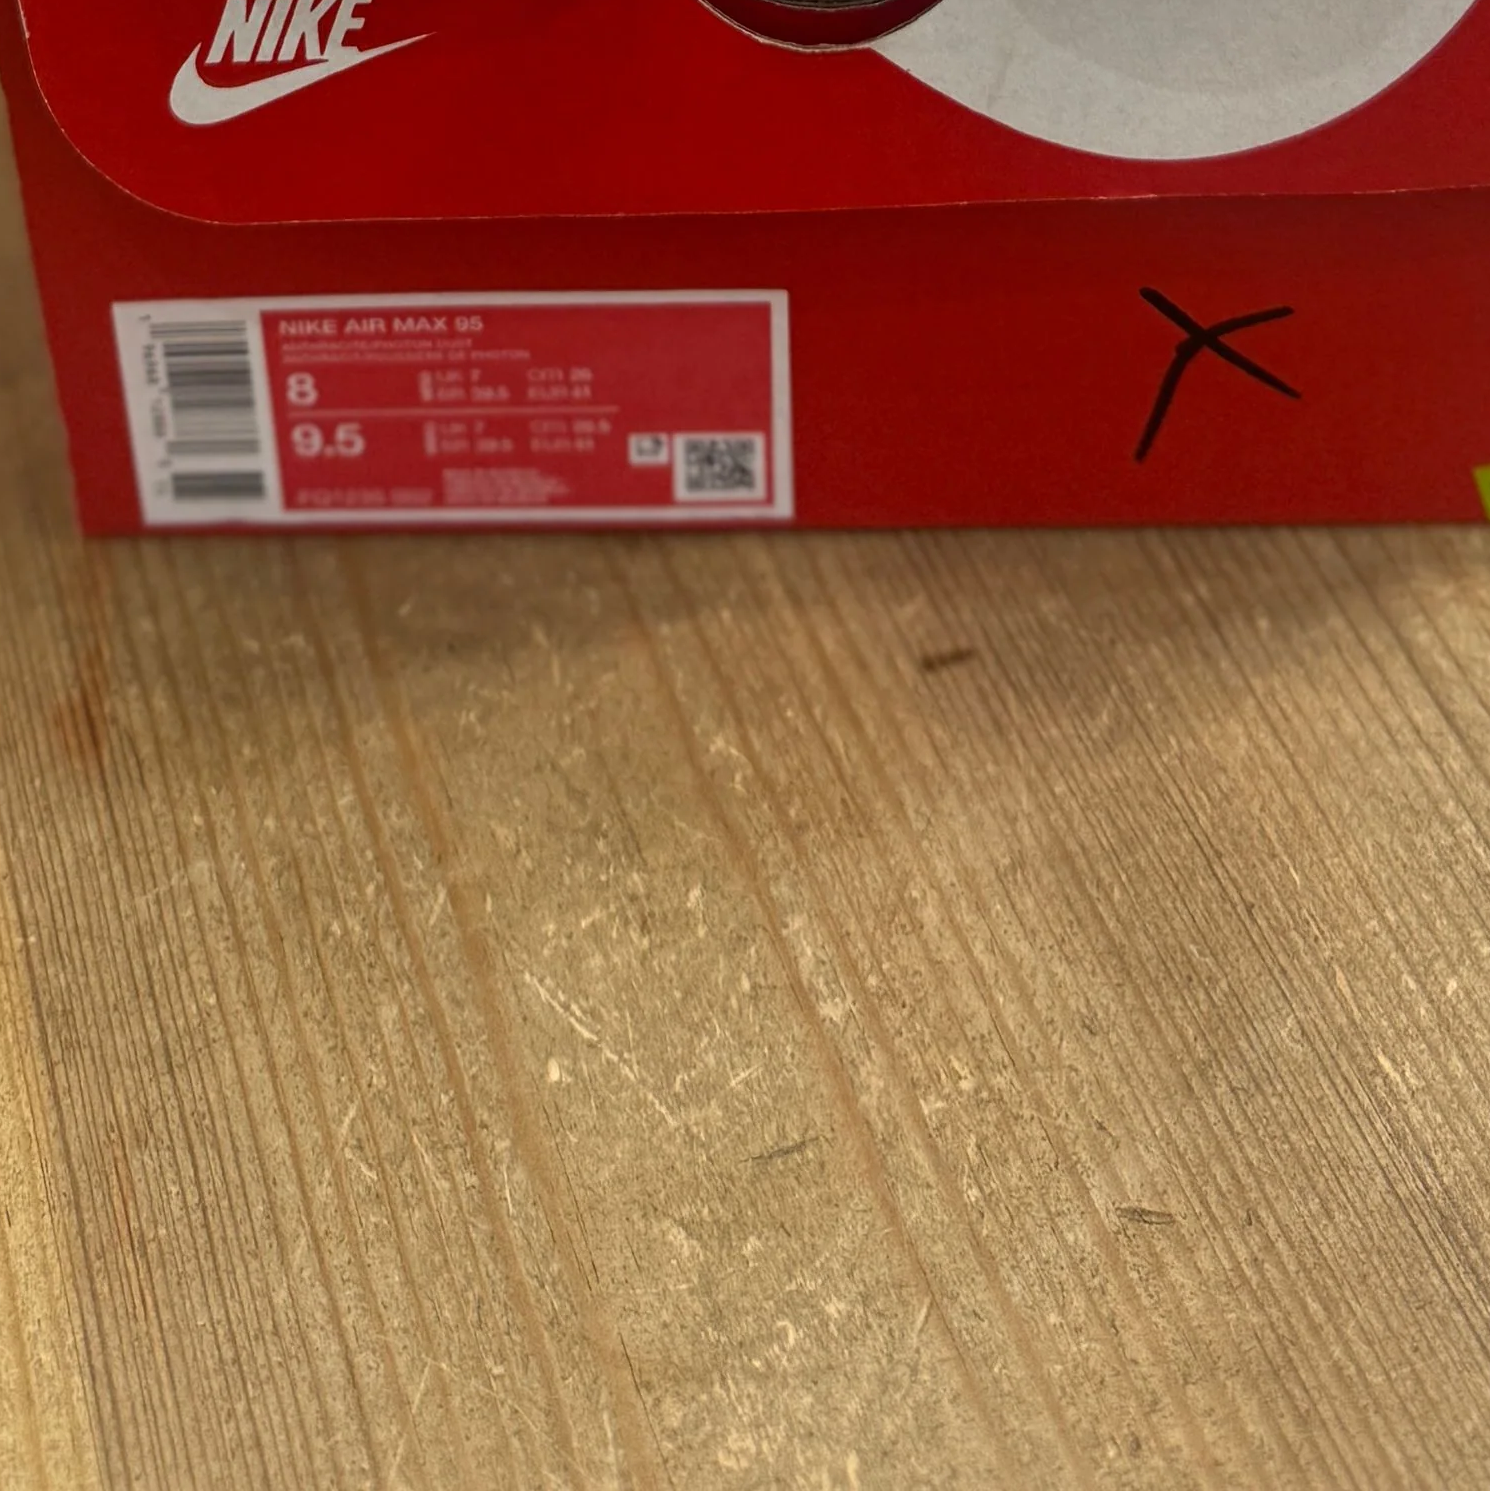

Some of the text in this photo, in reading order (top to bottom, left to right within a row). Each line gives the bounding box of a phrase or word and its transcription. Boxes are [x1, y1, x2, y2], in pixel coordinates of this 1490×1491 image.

[279, 316, 484, 335] NIKE AIR MAX 95
[286, 372, 318, 406] 8
[291, 422, 366, 457] 9.5
